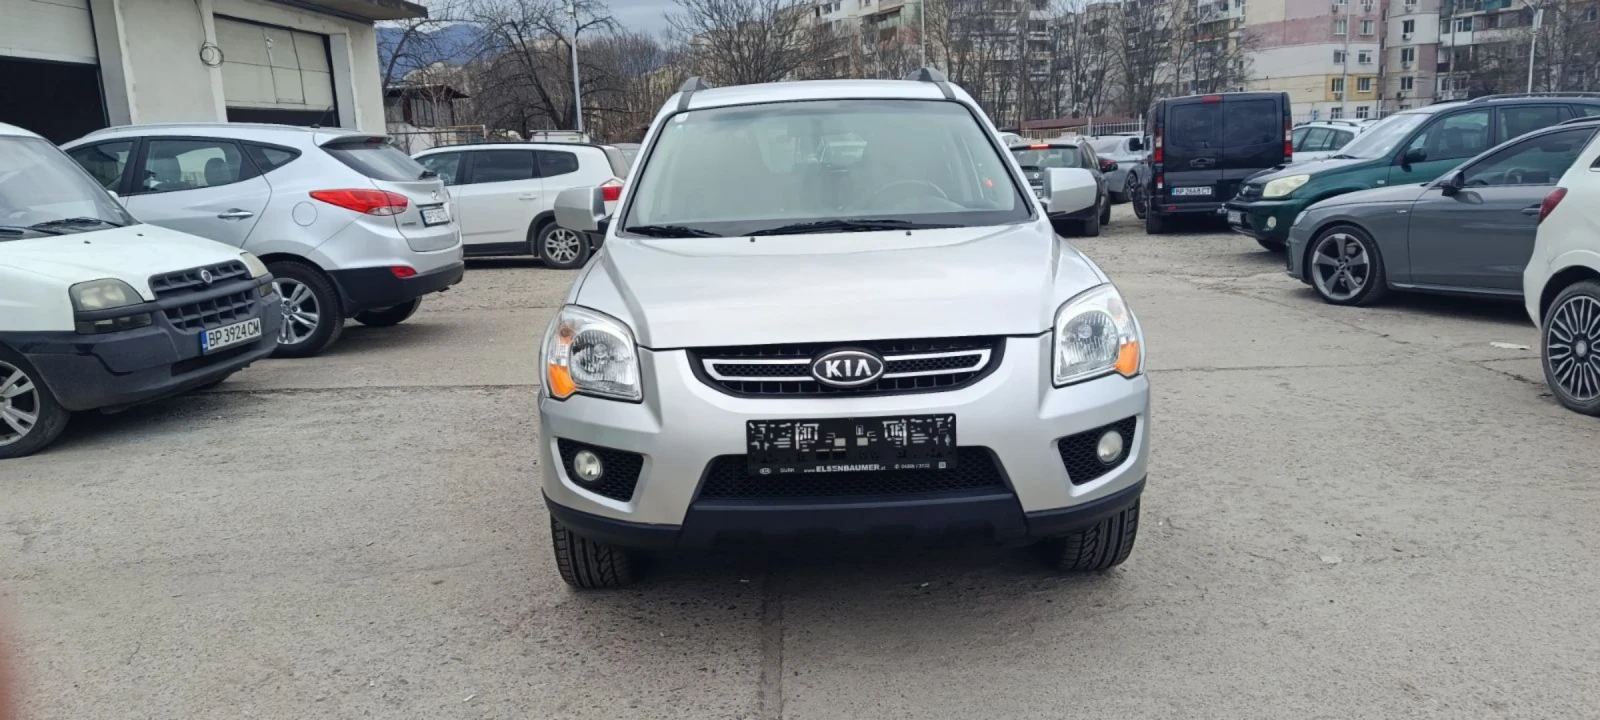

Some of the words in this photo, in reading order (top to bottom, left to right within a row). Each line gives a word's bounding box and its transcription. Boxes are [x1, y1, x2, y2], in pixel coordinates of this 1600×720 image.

[208, 330, 222, 347] BP
[224, 323, 247, 343] 3924
[247, 319, 260, 336] CM
[825, 358, 872, 378] KIA
